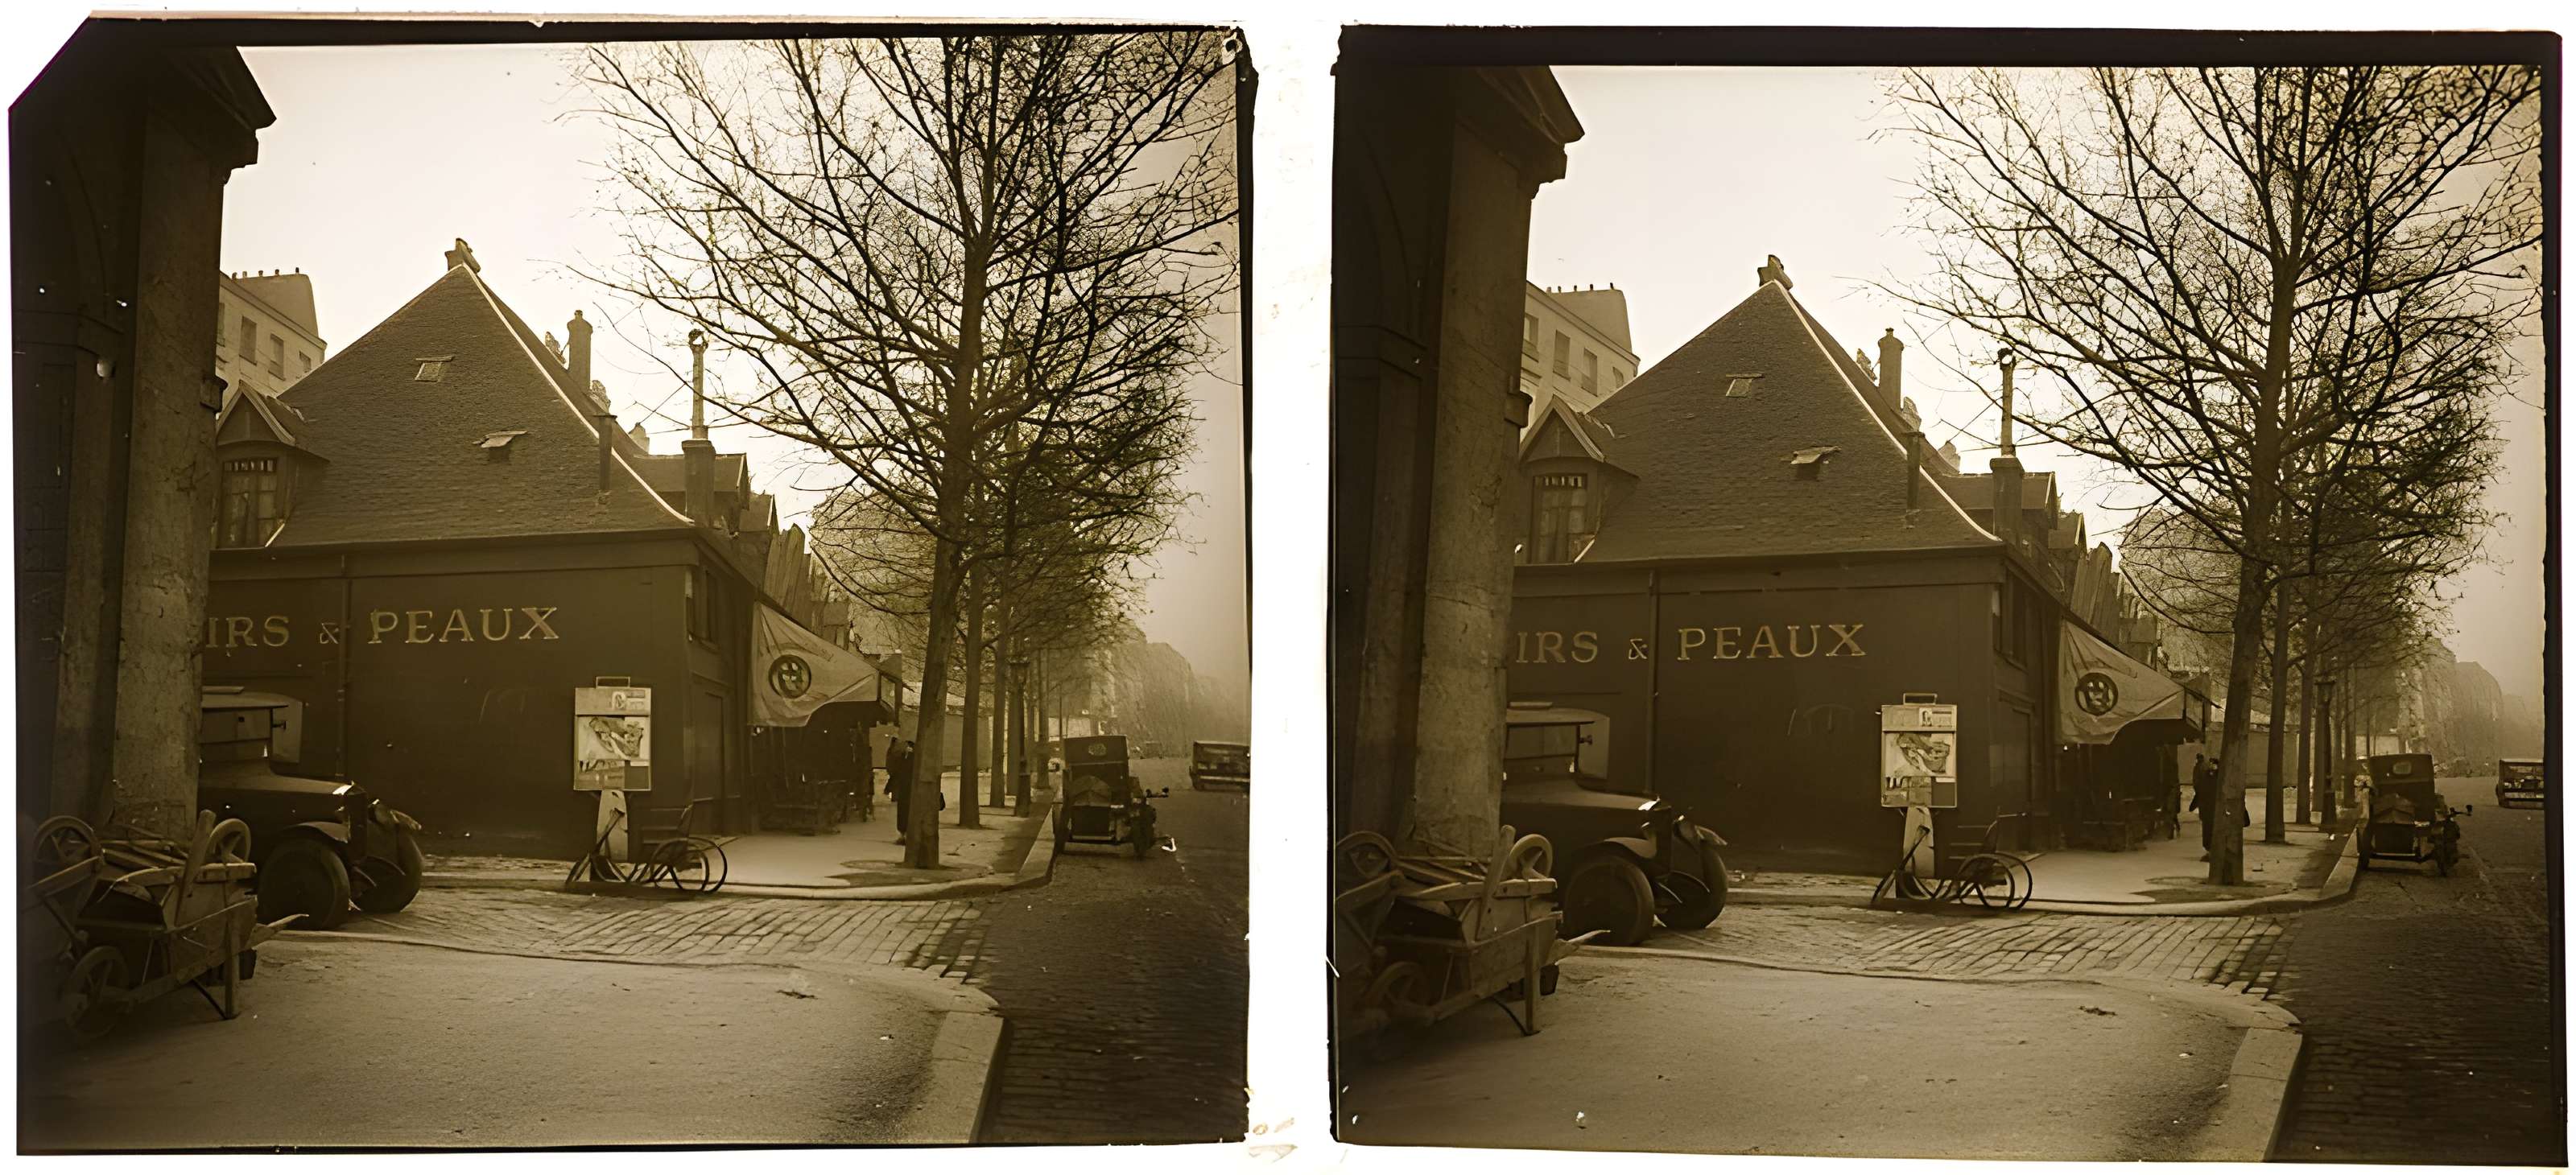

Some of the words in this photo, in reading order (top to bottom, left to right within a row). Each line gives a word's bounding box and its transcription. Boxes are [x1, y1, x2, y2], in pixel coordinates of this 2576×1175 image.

[368, 606, 559, 645] PEAUX
[1516, 631, 1599, 663] IRS
[1677, 624, 1867, 661] PEAUX
